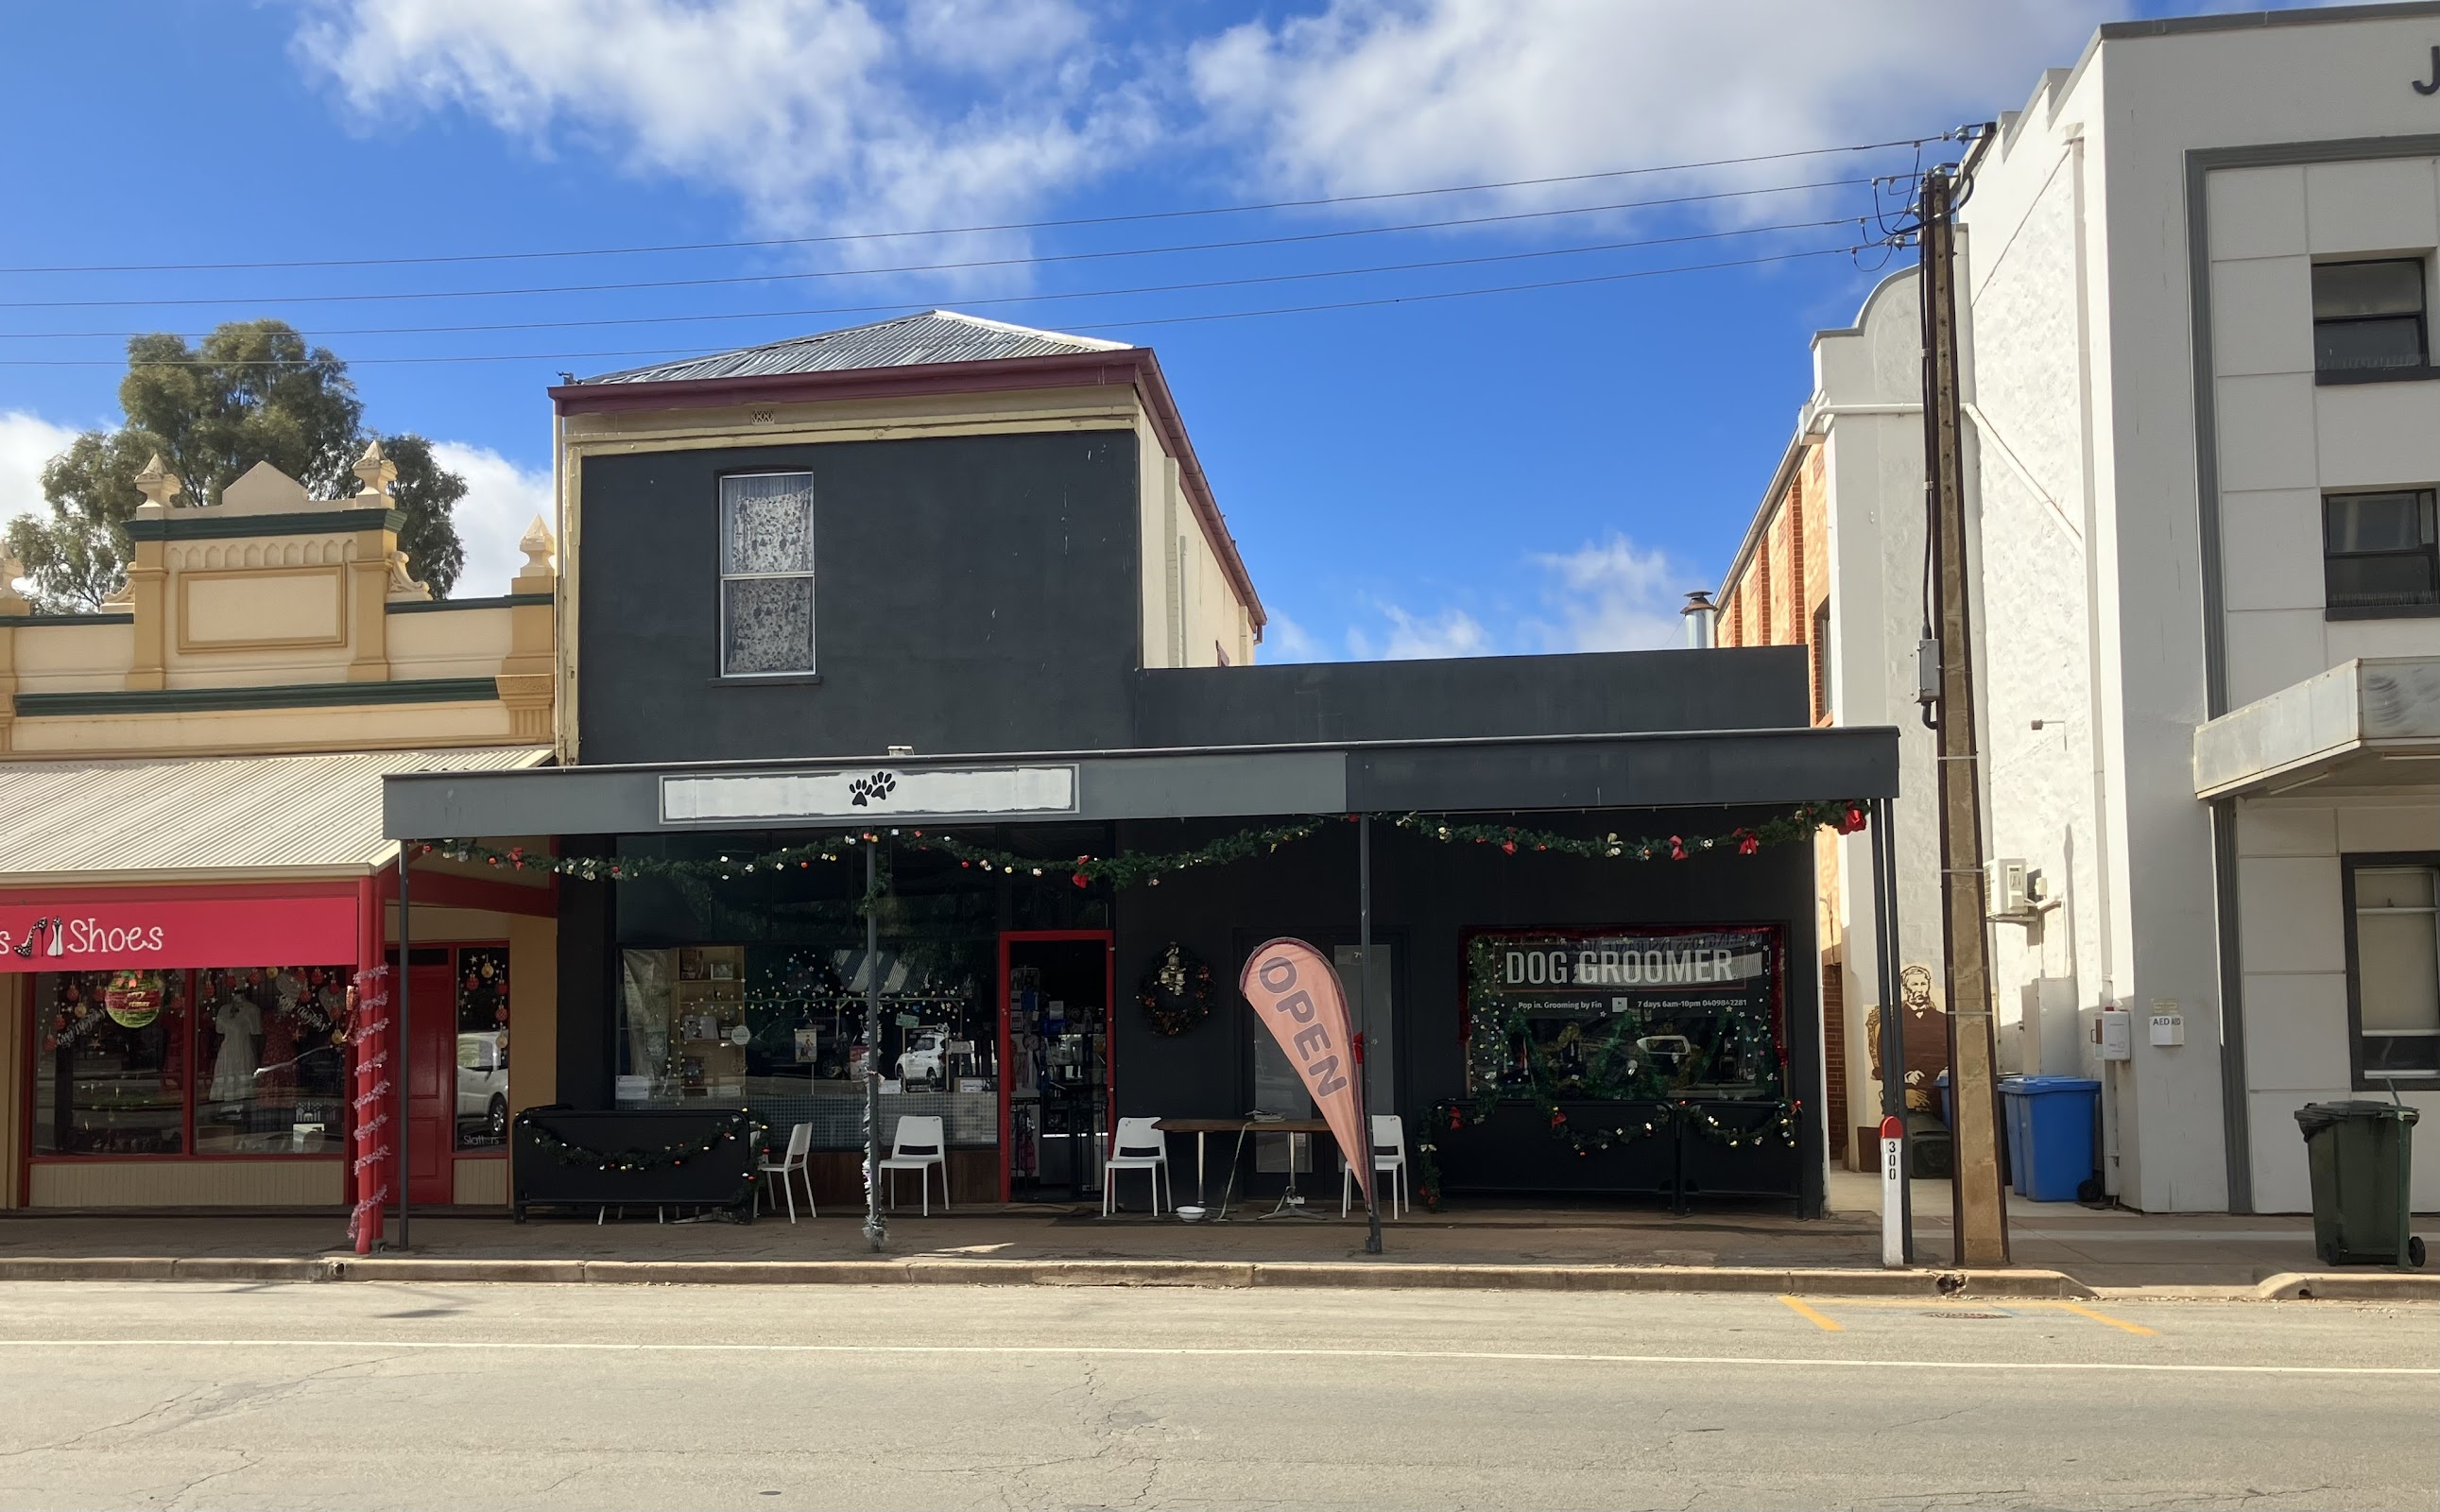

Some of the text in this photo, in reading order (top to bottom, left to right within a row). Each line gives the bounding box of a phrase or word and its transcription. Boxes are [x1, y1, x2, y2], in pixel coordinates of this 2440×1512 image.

[67, 918, 164, 953] Shoes
[1505, 949, 1733, 984] DOG GROOMER
[1518, 1002, 1533, 1010] Pop
[1533, 1001, 1543, 1009] in.
[1543, 1001, 1580, 1010] Grooming
[1580, 1001, 1590, 1010] by
[1590, 1001, 1603, 1009] Fin
[1642, 1000, 1661, 1009] days
[1661, 1000, 1701, 1009] 6am-10pm
[2153, 1018, 2171, 1026] AED
[1258, 955, 1349, 1099] OPEN
[1888, 1141, 1897, 1180] 300
